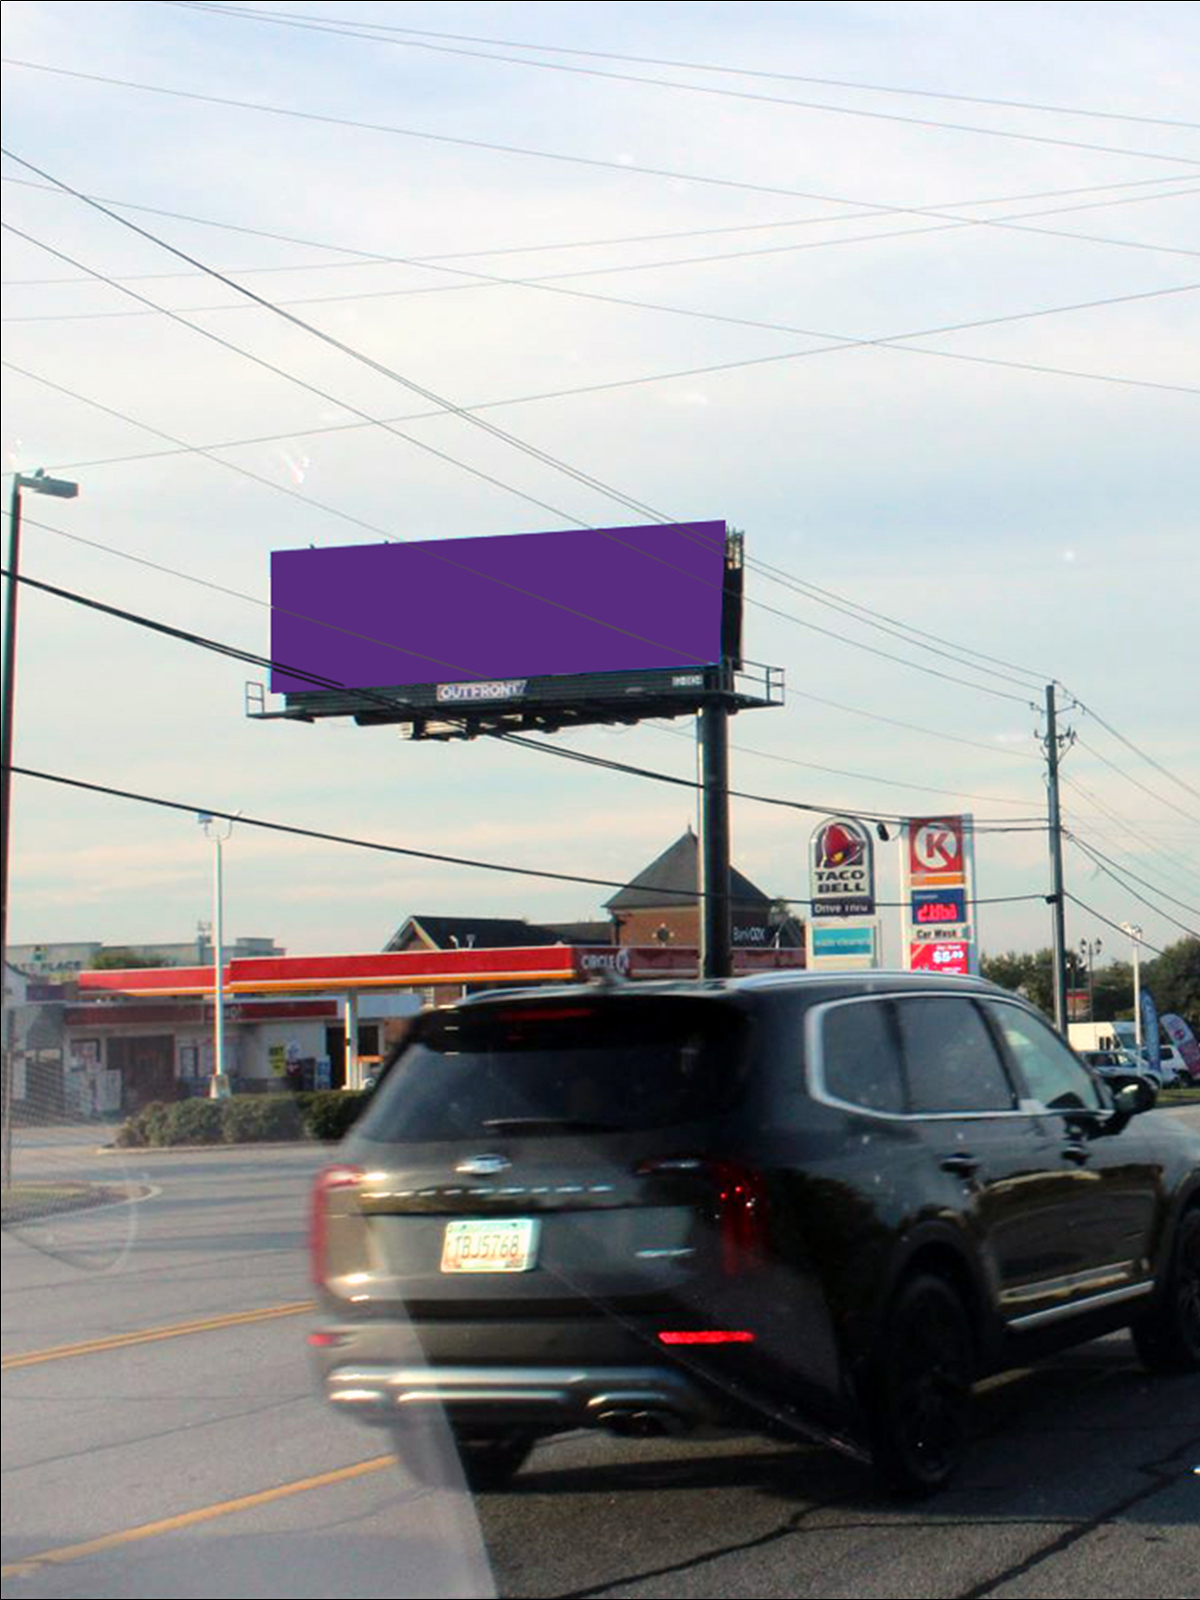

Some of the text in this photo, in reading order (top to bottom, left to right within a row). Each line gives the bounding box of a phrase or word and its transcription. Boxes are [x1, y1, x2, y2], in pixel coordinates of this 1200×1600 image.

[440, 683, 524, 698] OUTFRONT
[814, 869, 865, 881] TACO
[818, 882, 866, 893] BELL
[814, 904, 842, 913] Drive
[580, 955, 616, 969] CIRCLE
